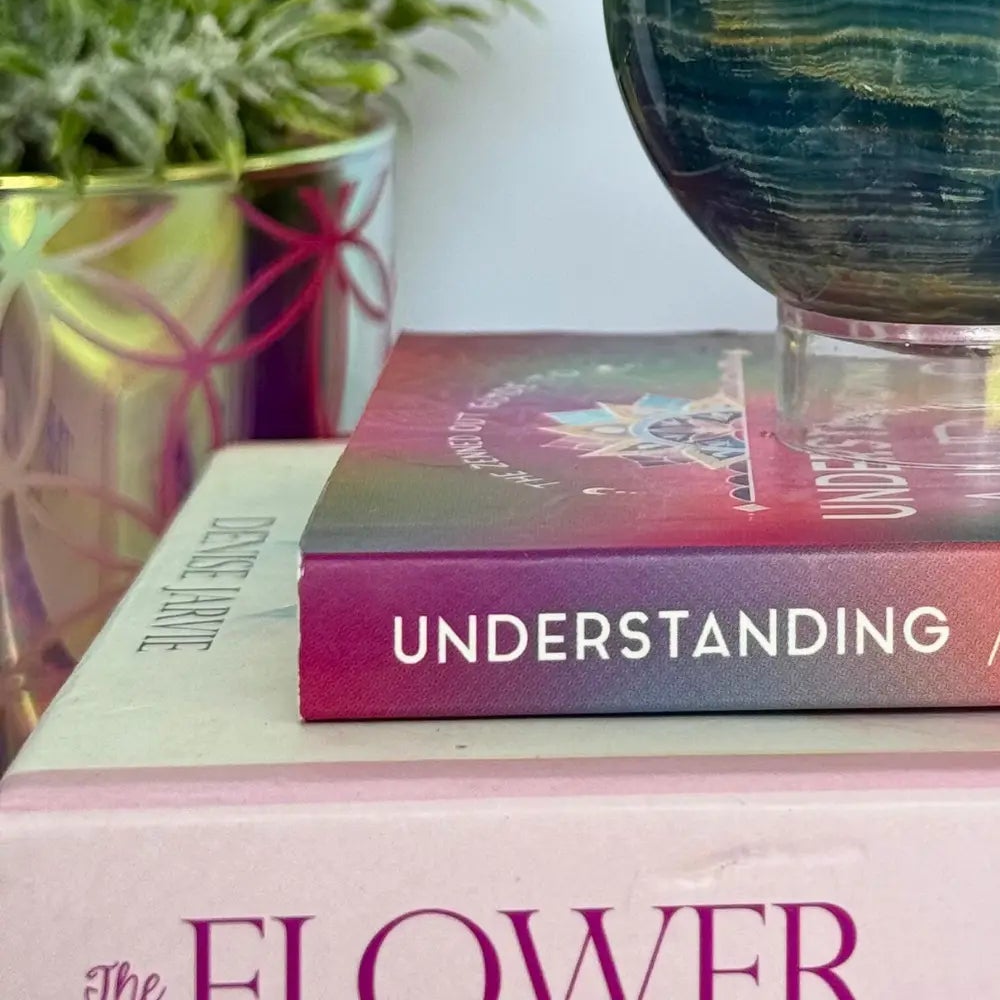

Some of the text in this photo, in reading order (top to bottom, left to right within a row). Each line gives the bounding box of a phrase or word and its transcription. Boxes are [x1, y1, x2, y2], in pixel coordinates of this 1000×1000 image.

[448, 411, 489, 433] OUT
[448, 435, 509, 470] ZENNED
[489, 470, 560, 489] THE
[136, 517, 277, 652] DENISE JARVIE
[393, 605, 950, 665] UNDERSTANDING
[181, 902, 860, 1000] FLOWER
